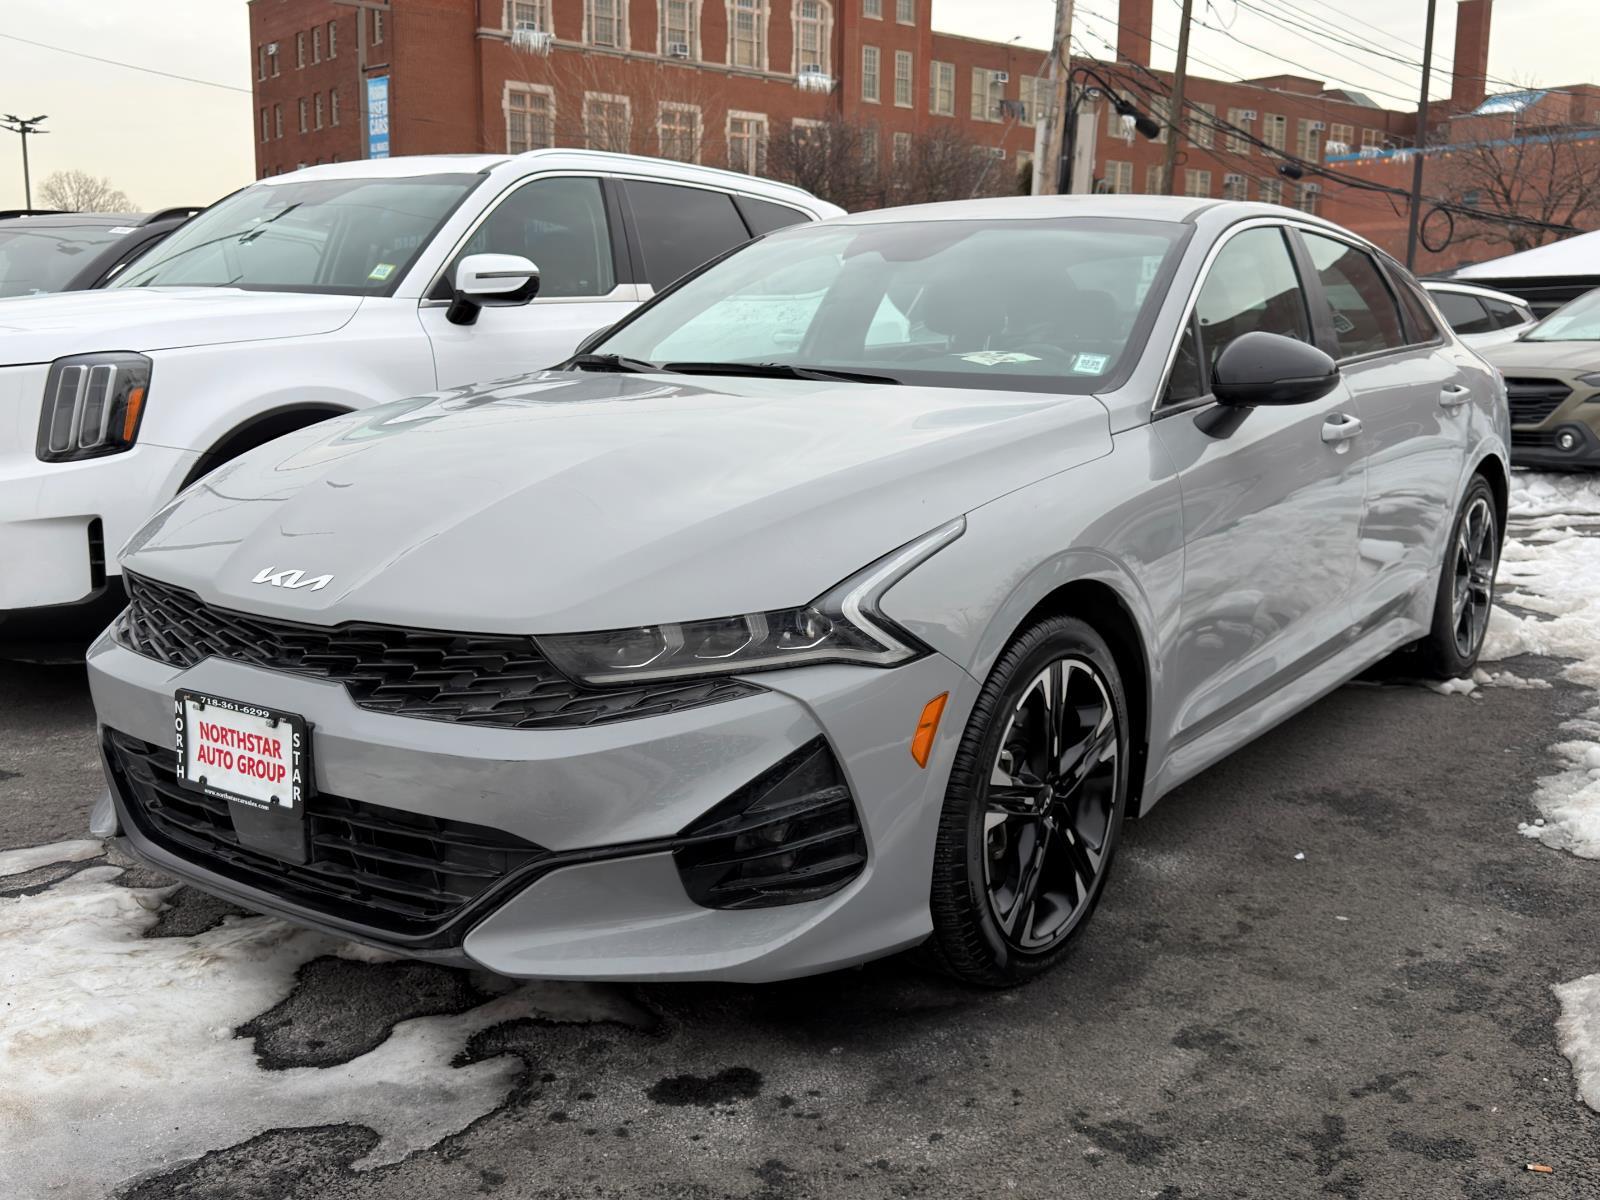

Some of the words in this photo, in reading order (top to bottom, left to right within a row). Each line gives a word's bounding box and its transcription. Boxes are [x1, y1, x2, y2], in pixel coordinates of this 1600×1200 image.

[251, 566, 335, 593] KIA
[200, 696, 270, 718] 718-361-6299
[175, 700, 185, 779] NORTH
[199, 721, 282, 760] NORTHSTAR
[197, 744, 233, 770] AUTO
[237, 754, 286, 784] GROUP
[292, 733, 302, 801] STAR
